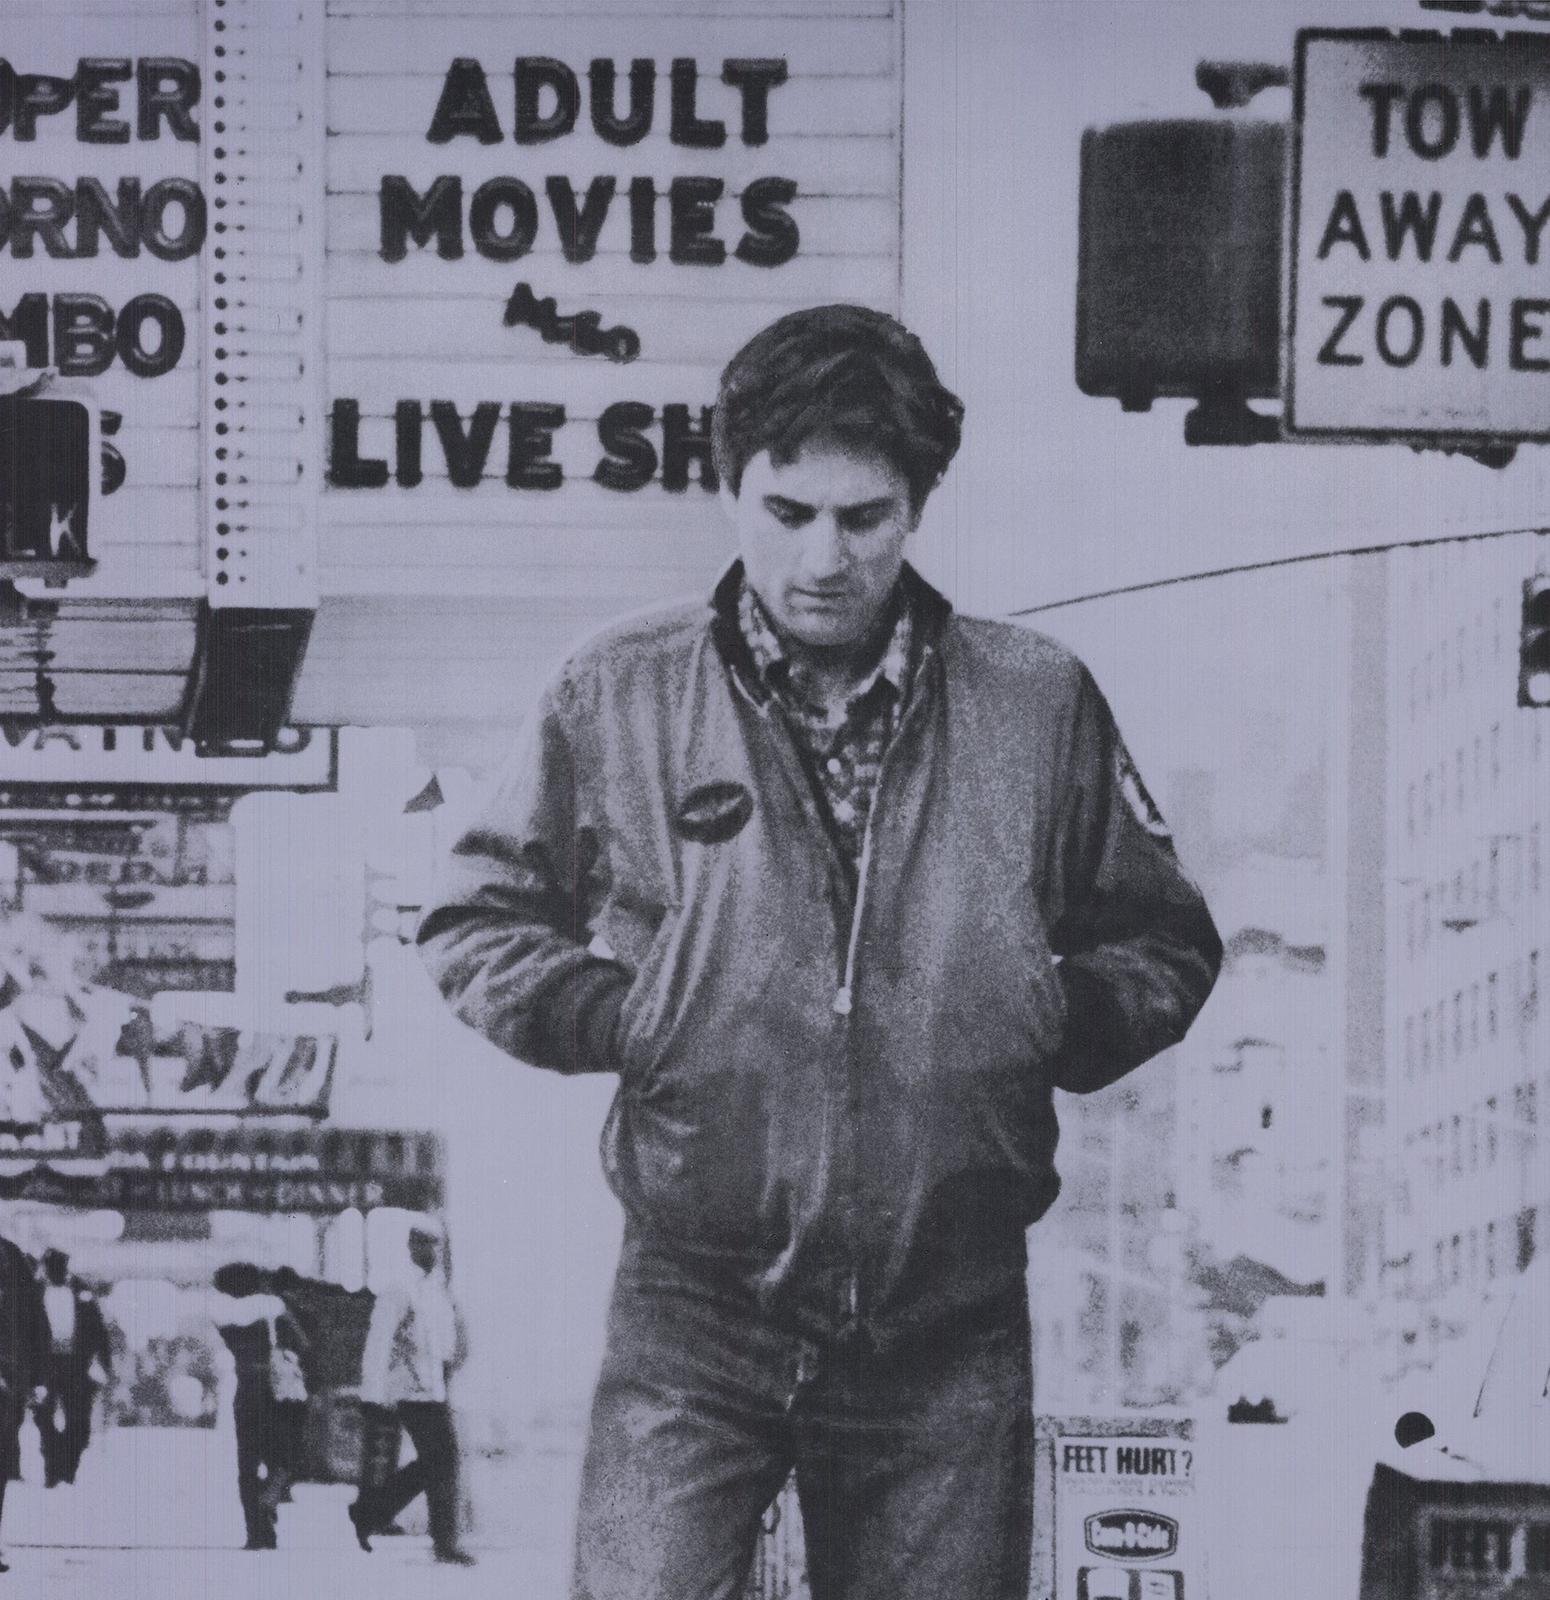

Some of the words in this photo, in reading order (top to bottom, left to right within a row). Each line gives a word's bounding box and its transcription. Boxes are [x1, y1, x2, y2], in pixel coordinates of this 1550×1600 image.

[0, 57, 201, 144] PER
[426, 57, 788, 148] ADULT
[1357, 82, 1532, 161] TOW
[0, 176, 207, 262] RNO
[379, 175, 800, 268] MOVIES
[1315, 189, 1550, 265] AWAY
[1316, 295, 1550, 373] ZONE
[325, 398, 566, 491] LIVE
[594, 401, 720, 494] SH
[1062, 1444, 1109, 1474] FEET
[1116, 1446, 1194, 1478] HURT?
